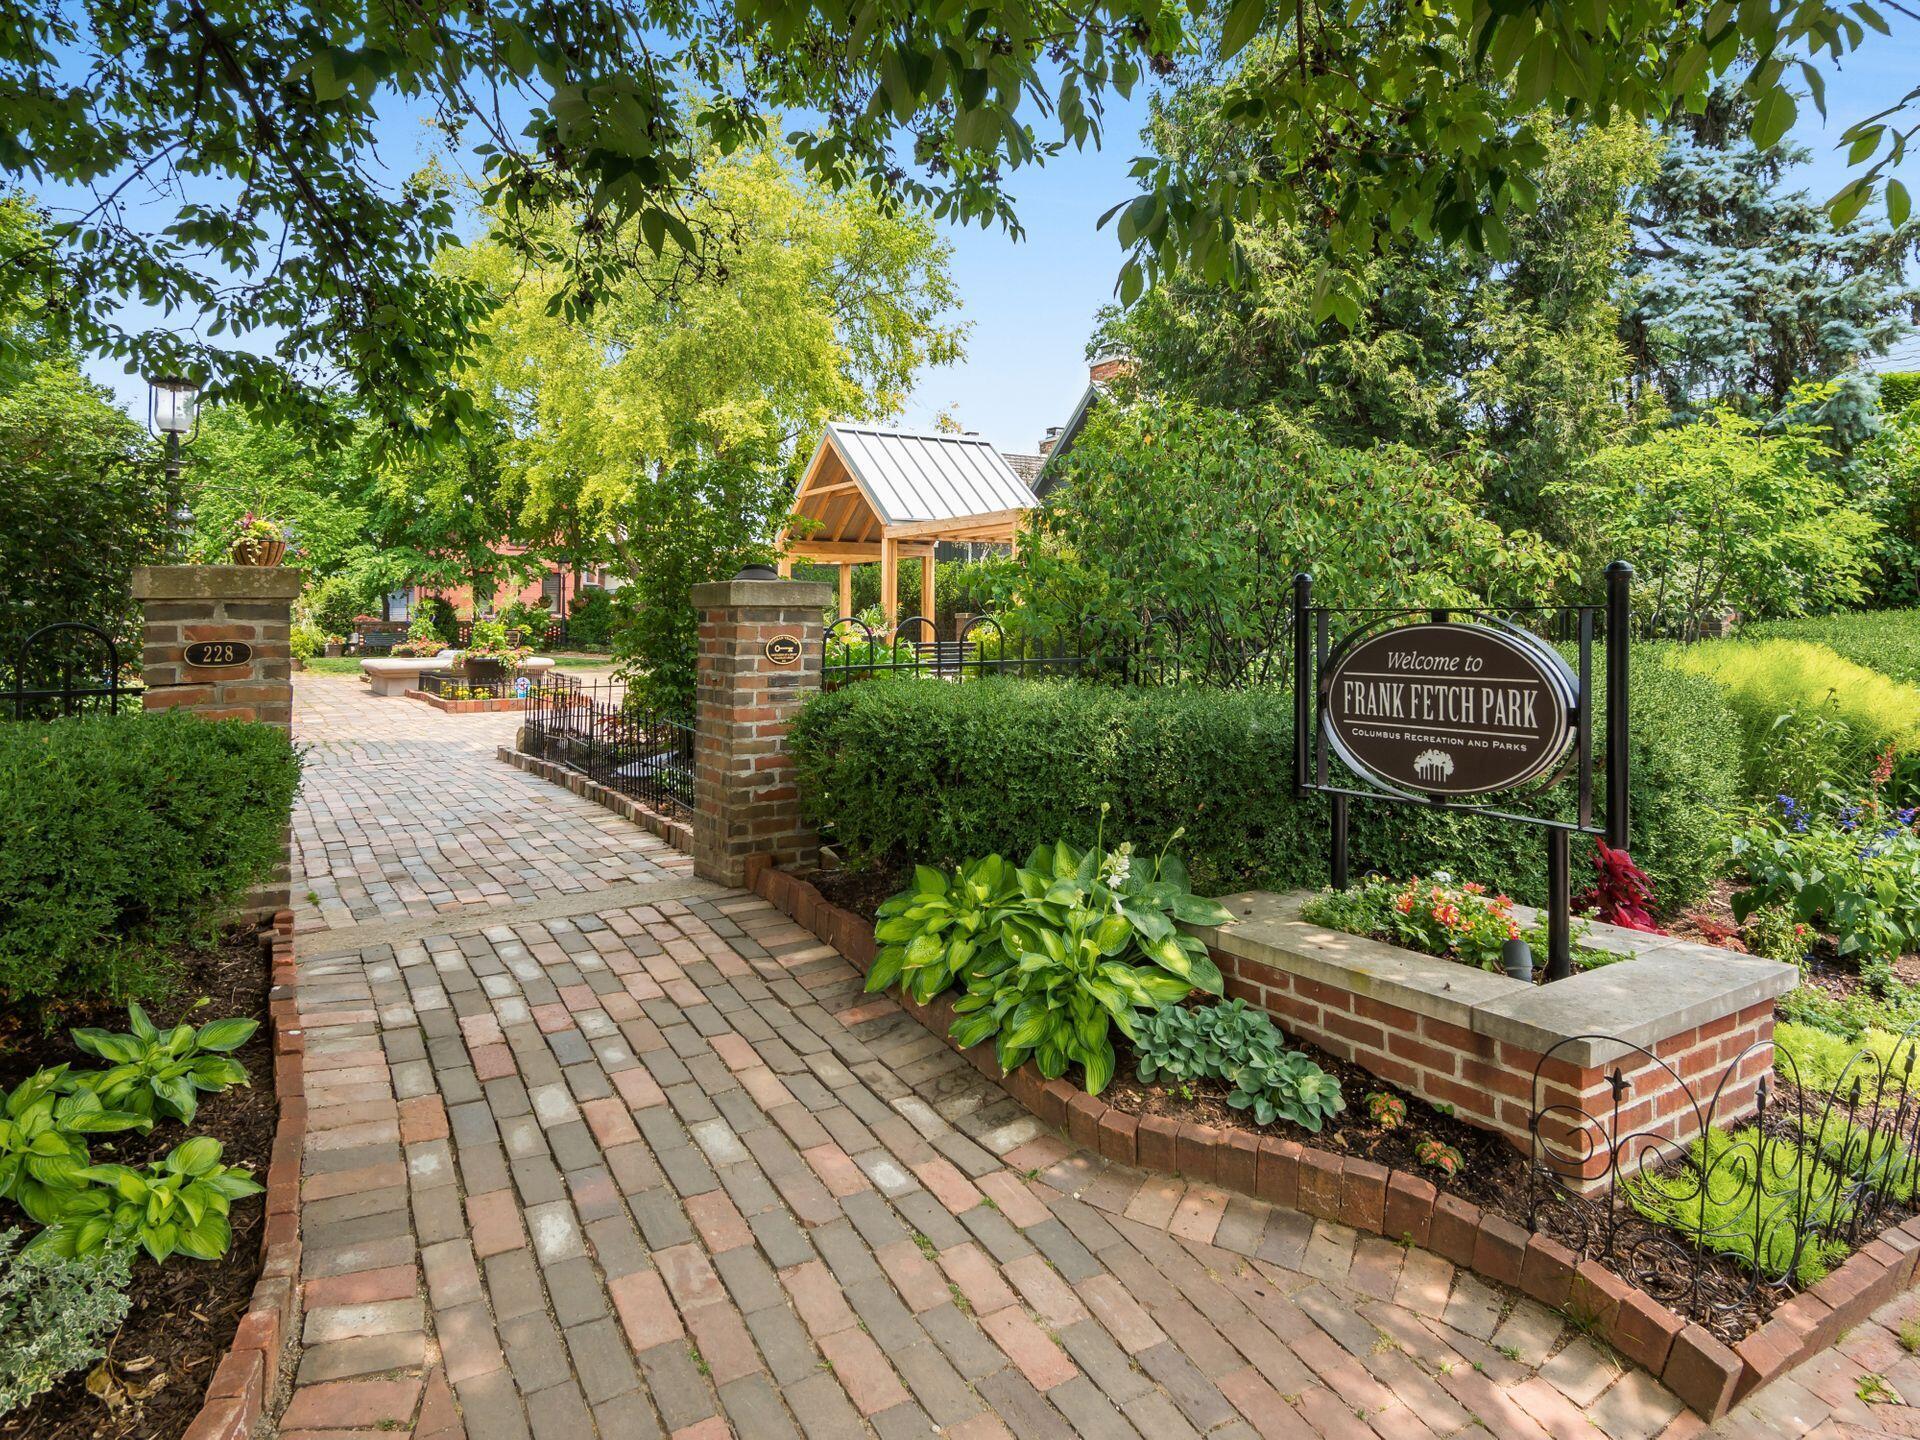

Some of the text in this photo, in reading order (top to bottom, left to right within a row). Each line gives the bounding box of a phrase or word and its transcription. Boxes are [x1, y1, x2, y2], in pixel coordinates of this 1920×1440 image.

[203, 645, 234, 663] 228
[1387, 650, 1483, 672] Welcome to
[1343, 680, 1538, 729] FRANK FETCH PARK
[1351, 727, 1527, 752] COLUMBUS RECREATION AND PARKS
